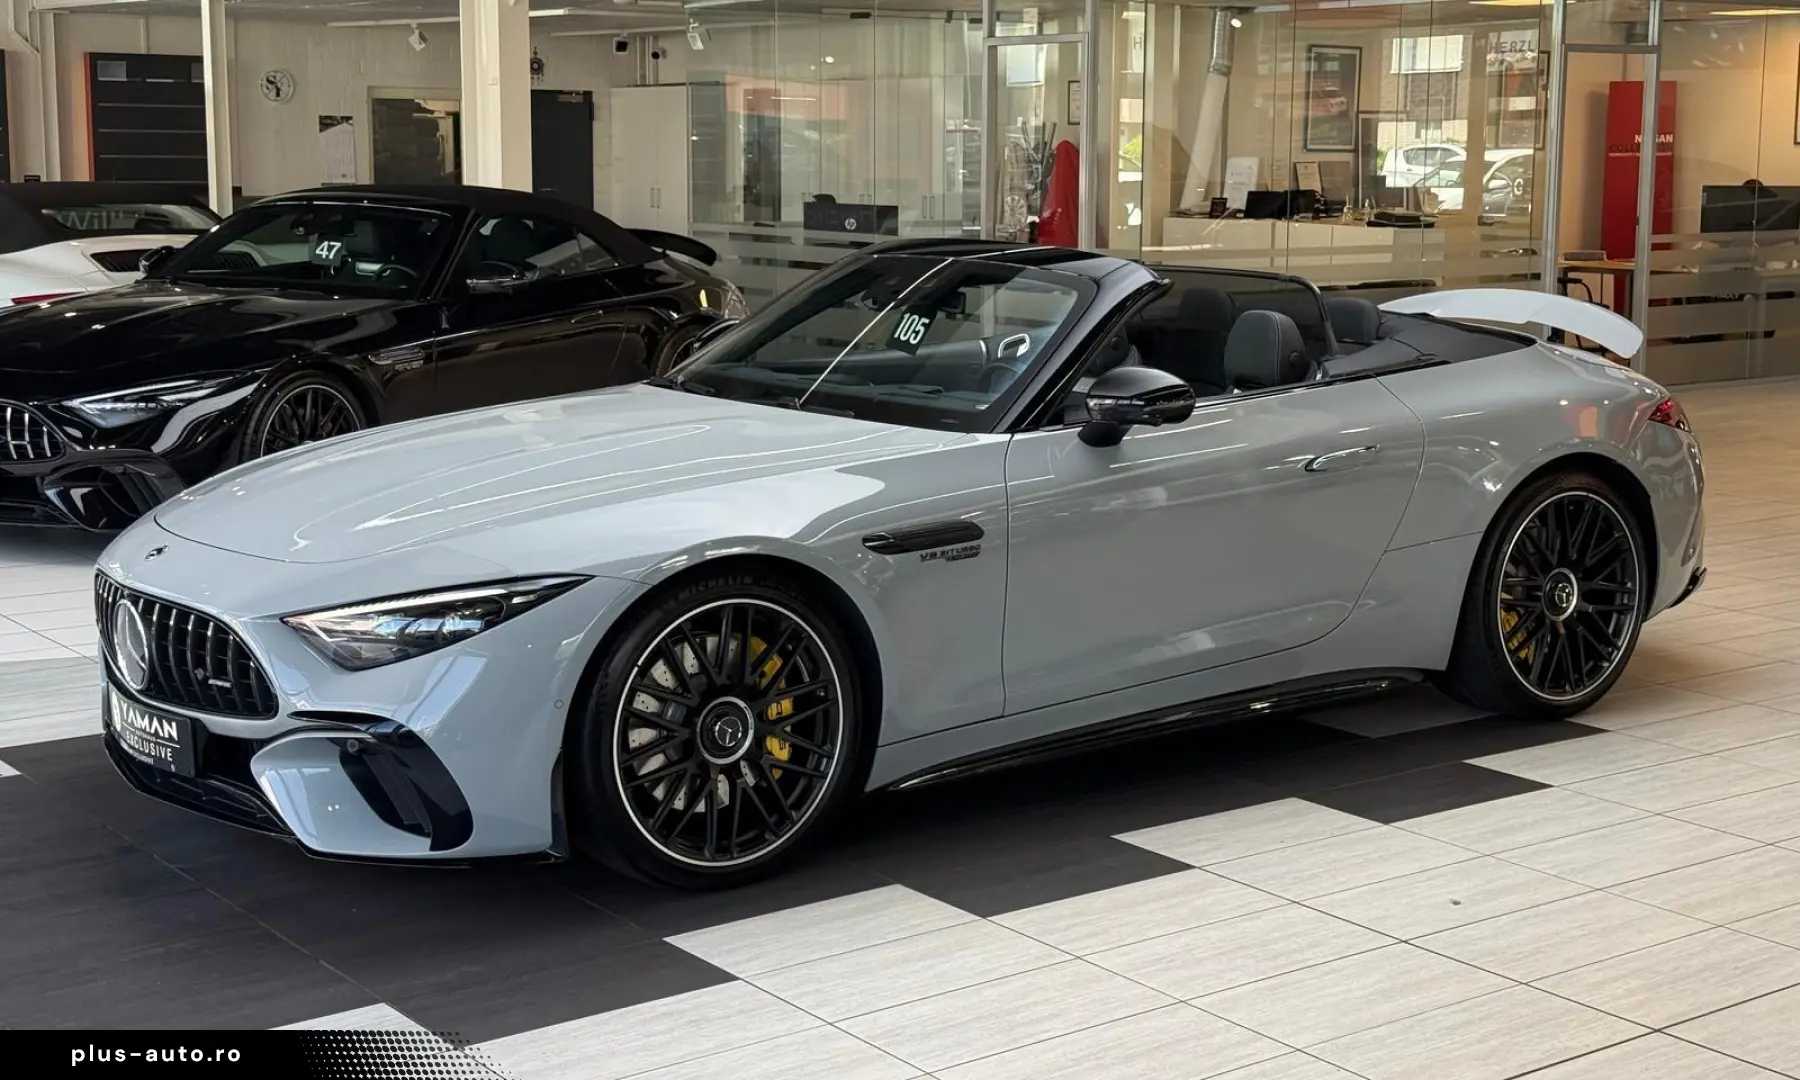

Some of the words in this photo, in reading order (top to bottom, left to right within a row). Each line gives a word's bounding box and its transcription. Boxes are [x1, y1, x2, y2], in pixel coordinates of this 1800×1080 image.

[315, 241, 342, 259] 47
[894, 313, 930, 344] 105
[120, 699, 178, 741] YAMAN
[126, 730, 173, 762] EXCLUSIVE
